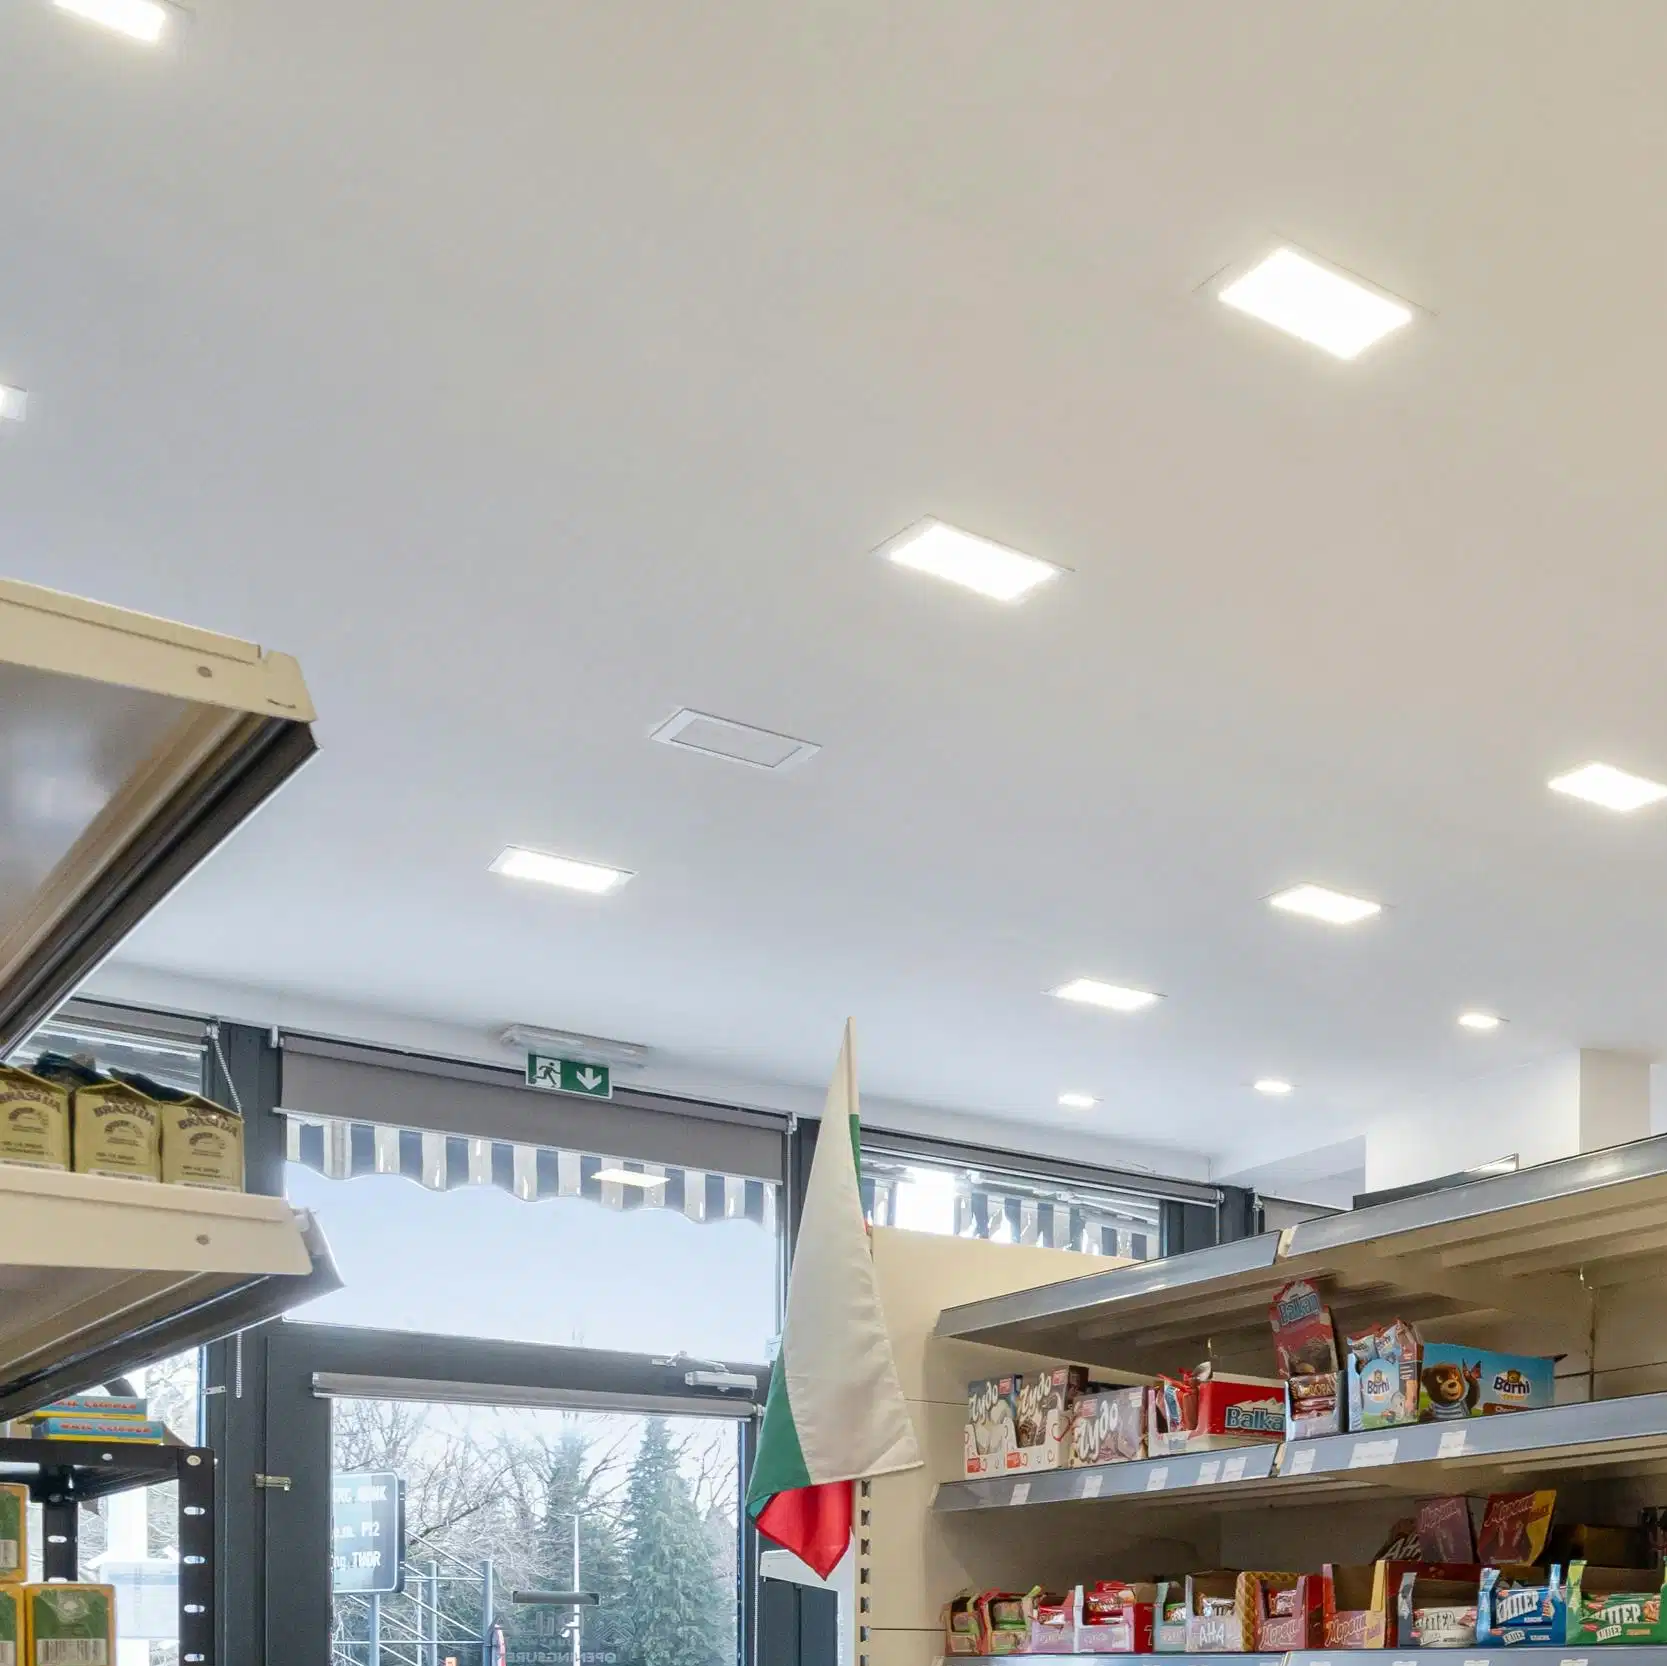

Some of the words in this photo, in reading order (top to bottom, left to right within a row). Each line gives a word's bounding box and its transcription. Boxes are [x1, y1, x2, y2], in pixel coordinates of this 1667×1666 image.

[1366, 1377, 1390, 1396] Barni
[1493, 1374, 1531, 1395] Barni
[1225, 1405, 1285, 1432] Balka
